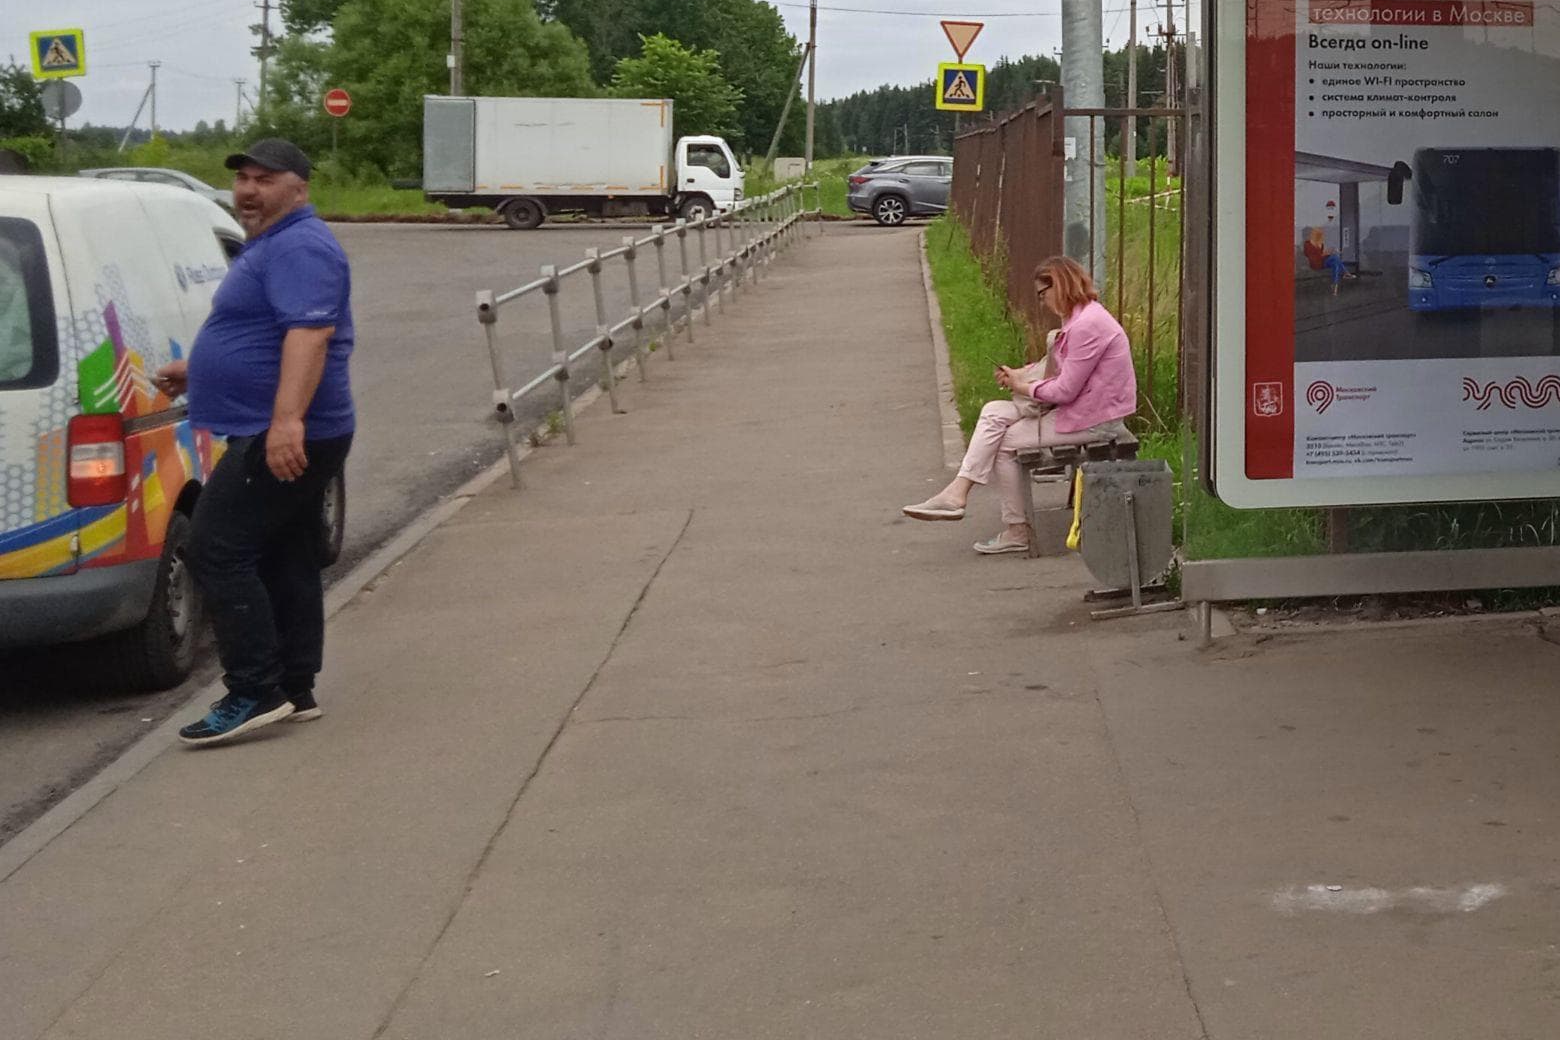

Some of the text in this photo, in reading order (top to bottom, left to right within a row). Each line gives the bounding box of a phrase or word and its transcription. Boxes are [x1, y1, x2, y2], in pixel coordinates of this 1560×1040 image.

[1313, 5, 1526, 23] технологии в Москве
[1308, 34, 1429, 52] Всегда on-line
[1308, 60, 1407, 71] Наши технологии:
[1322, 76, 1466, 89] единое WI-FI пространство
[1322, 94, 1457, 105] система климат-контроля
[1322, 108, 1499, 121] просторный и комфортный салон
